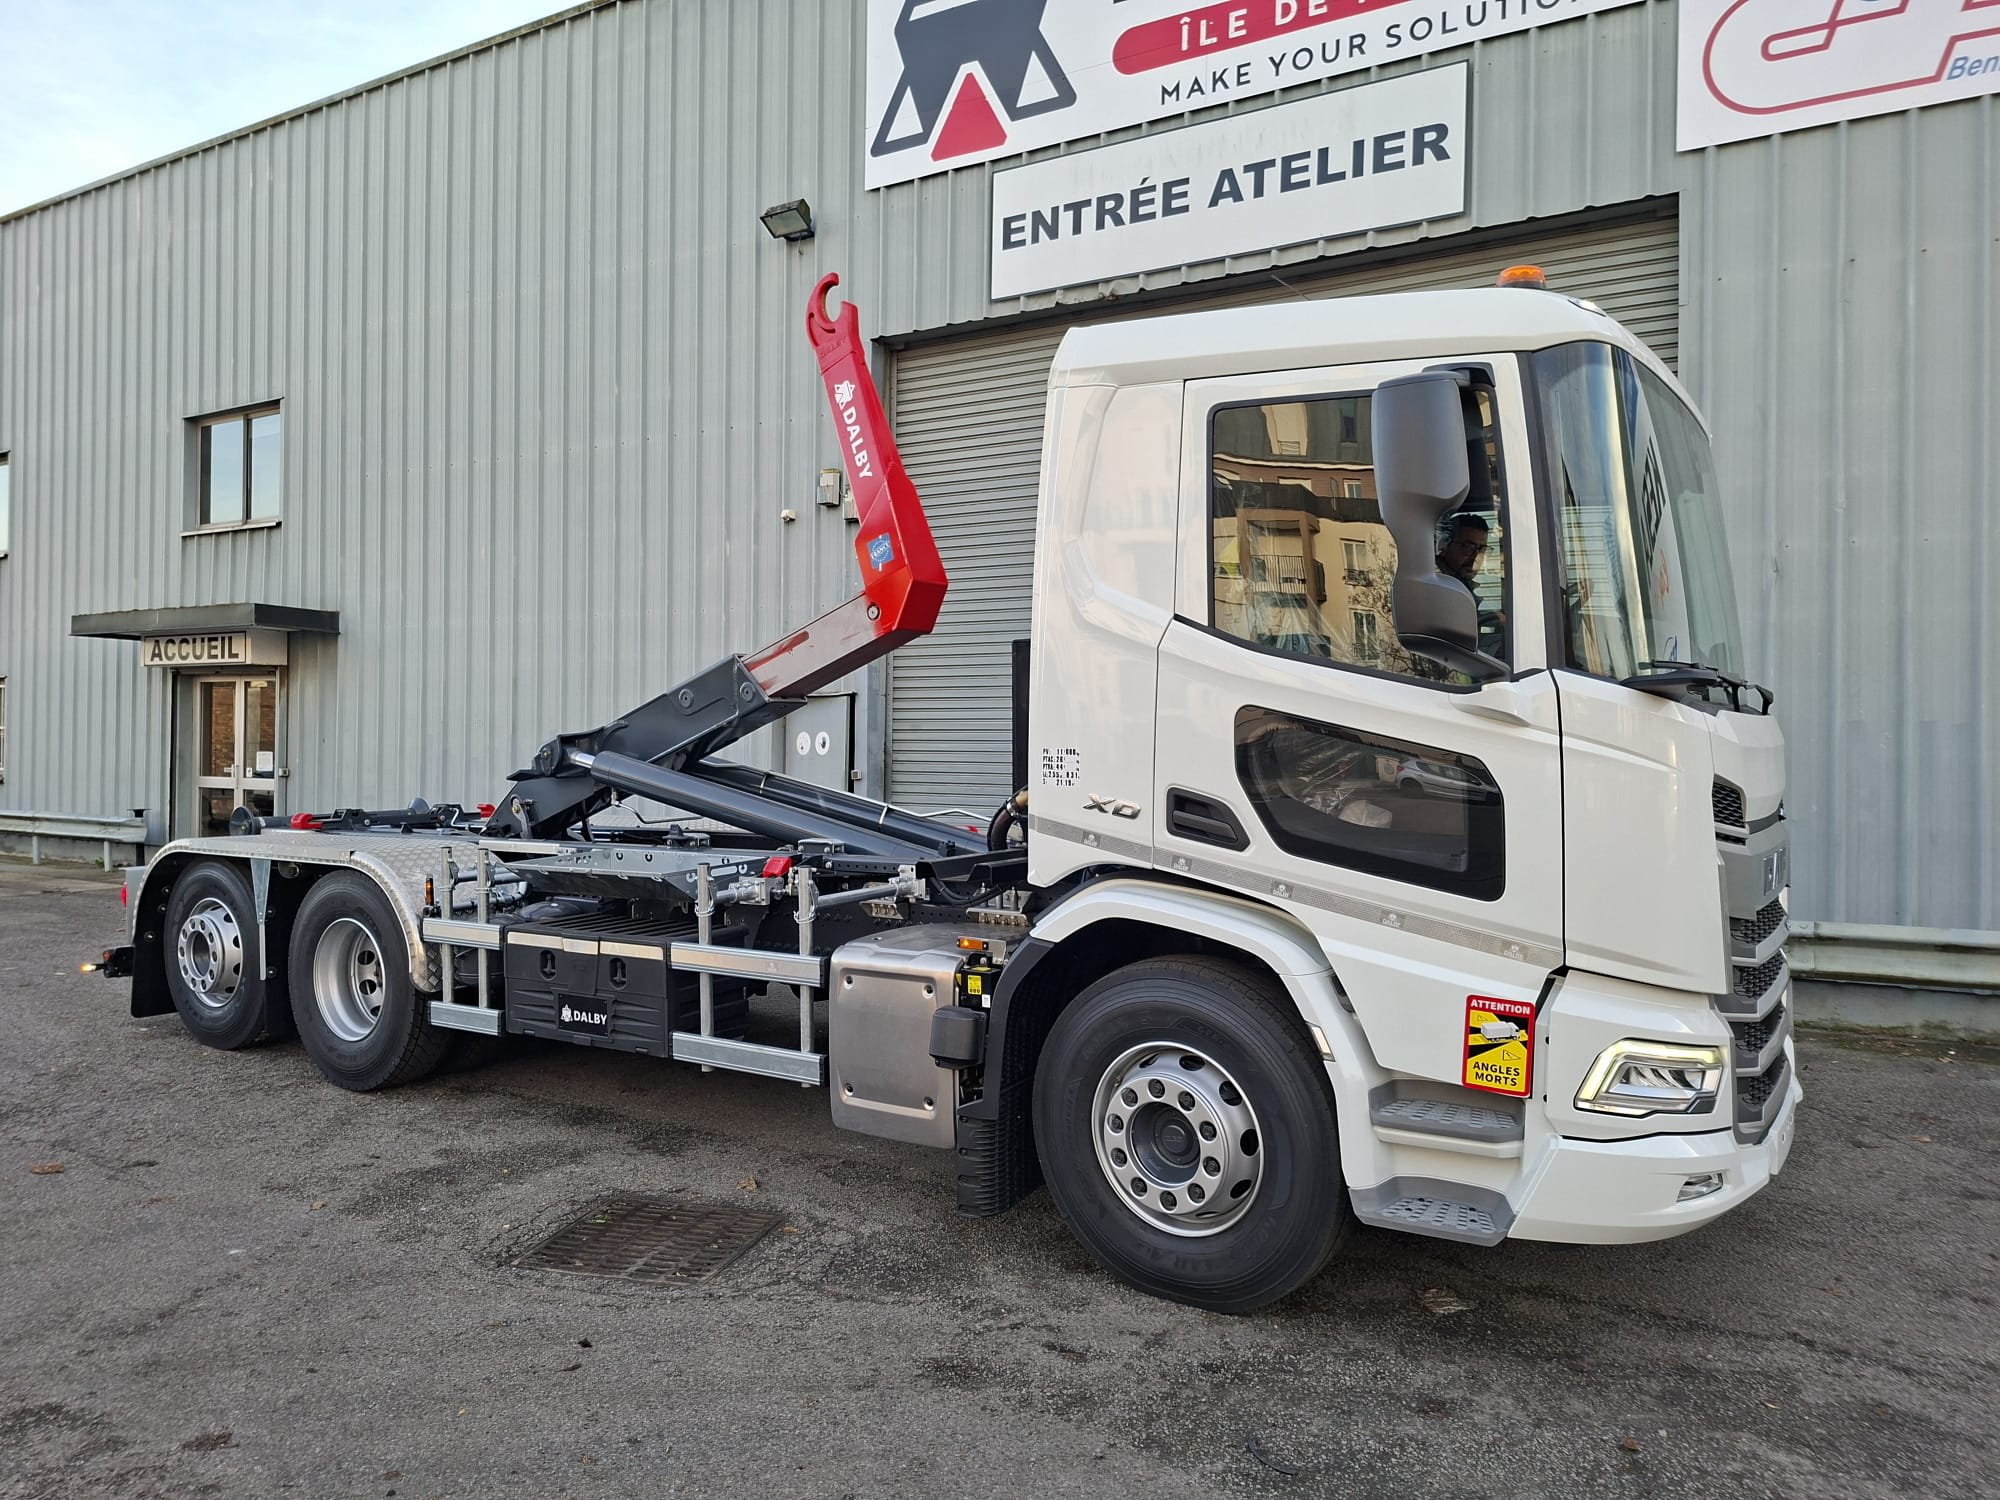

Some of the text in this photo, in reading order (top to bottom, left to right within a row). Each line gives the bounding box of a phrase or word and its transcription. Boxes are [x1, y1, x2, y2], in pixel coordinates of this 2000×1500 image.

[1179, 0, 1329, 51] ÎLE DE
[1161, 62, 1251, 105] MAKE
[1268, 33, 1366, 77] YOUR
[1946, 55, 2000, 80] Ben
[1002, 122, 1451, 251] ENTRÉE ATELIER
[843, 406, 873, 478] DALBY
[150, 635, 240, 662] ACCUEIL
[573, 1010, 608, 1025] DALBY
[1471, 999, 1531, 1014] ATTENTION
[1473, 1061, 1520, 1077] ANGLES
[1475, 1072, 1518, 1086] MORTS
